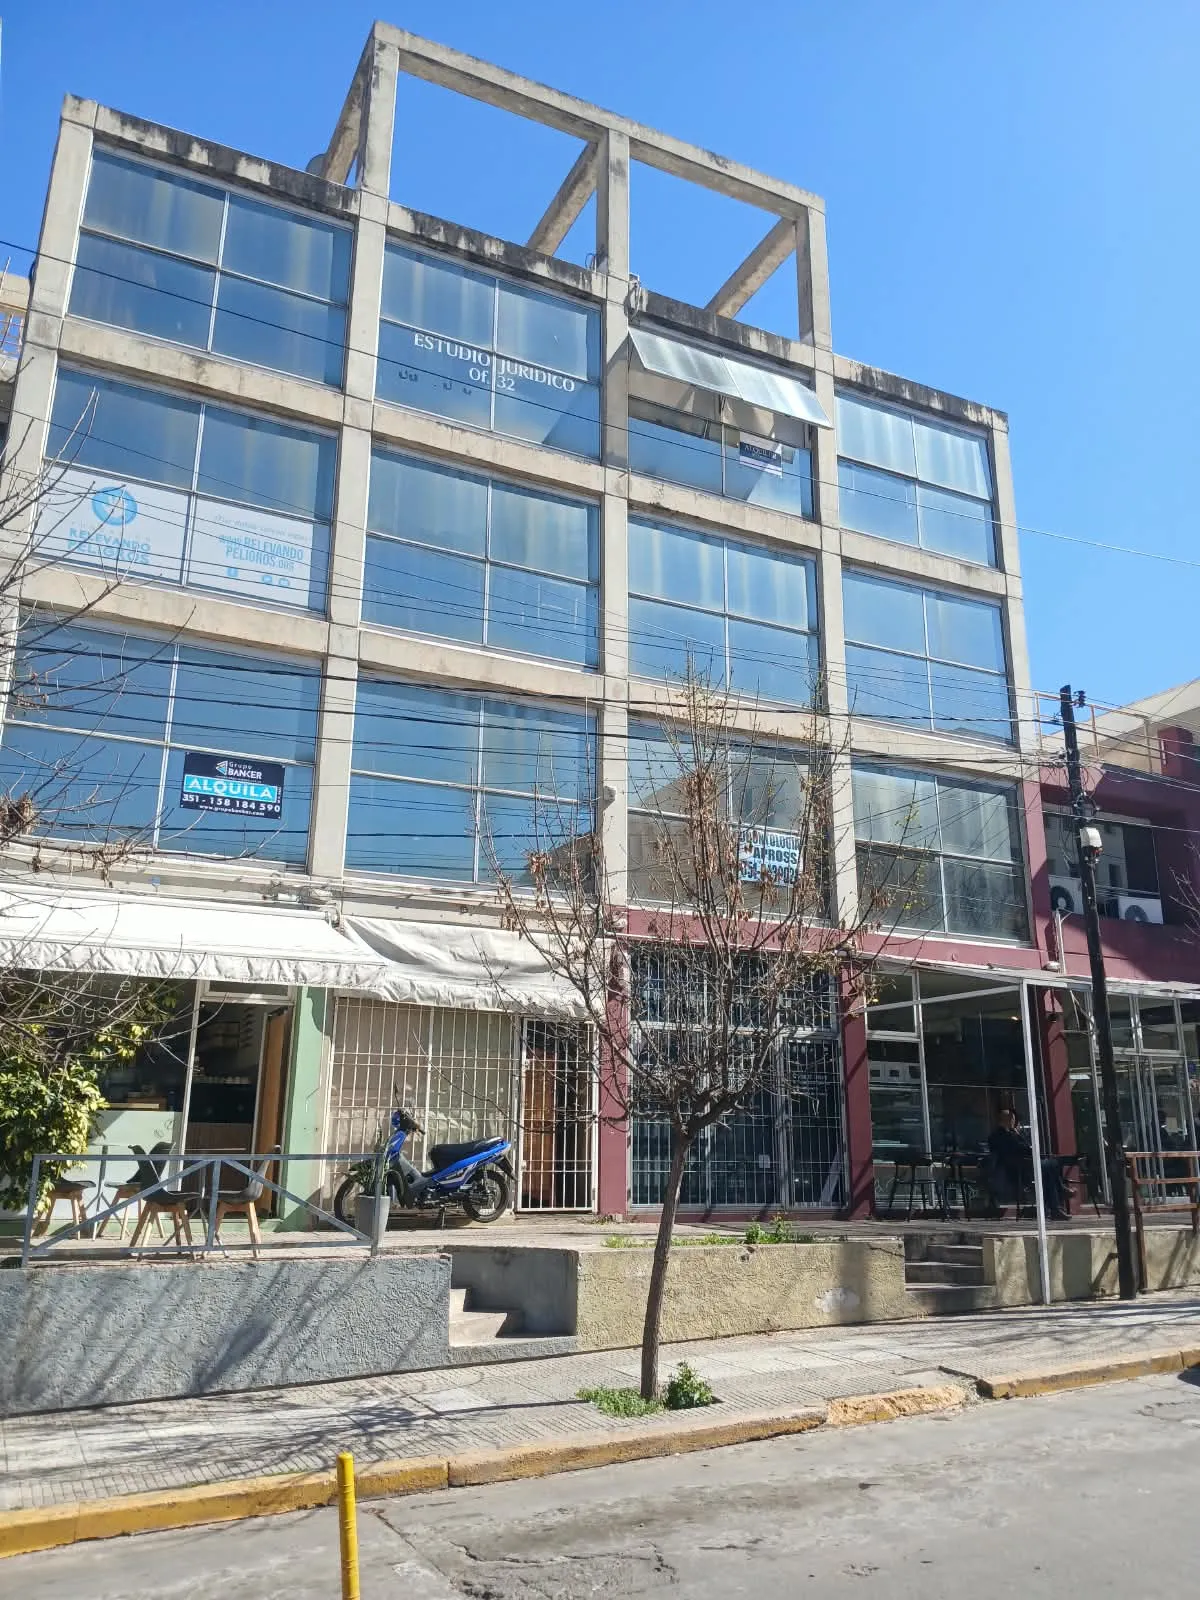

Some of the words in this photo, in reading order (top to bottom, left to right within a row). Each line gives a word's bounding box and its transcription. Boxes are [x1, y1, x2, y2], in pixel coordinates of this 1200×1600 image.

[414, 333, 490, 366] ESTUDIO
[498, 359, 575, 393] JURIDICO
[469, 367, 490, 385] Of.
[498, 375, 515, 392] 32
[188, 777, 273, 800] ALQUILA
[182, 793, 199, 803] 351
[209, 796, 231, 806] 158
[236, 800, 256, 809] 184
[259, 803, 281, 813] 590
